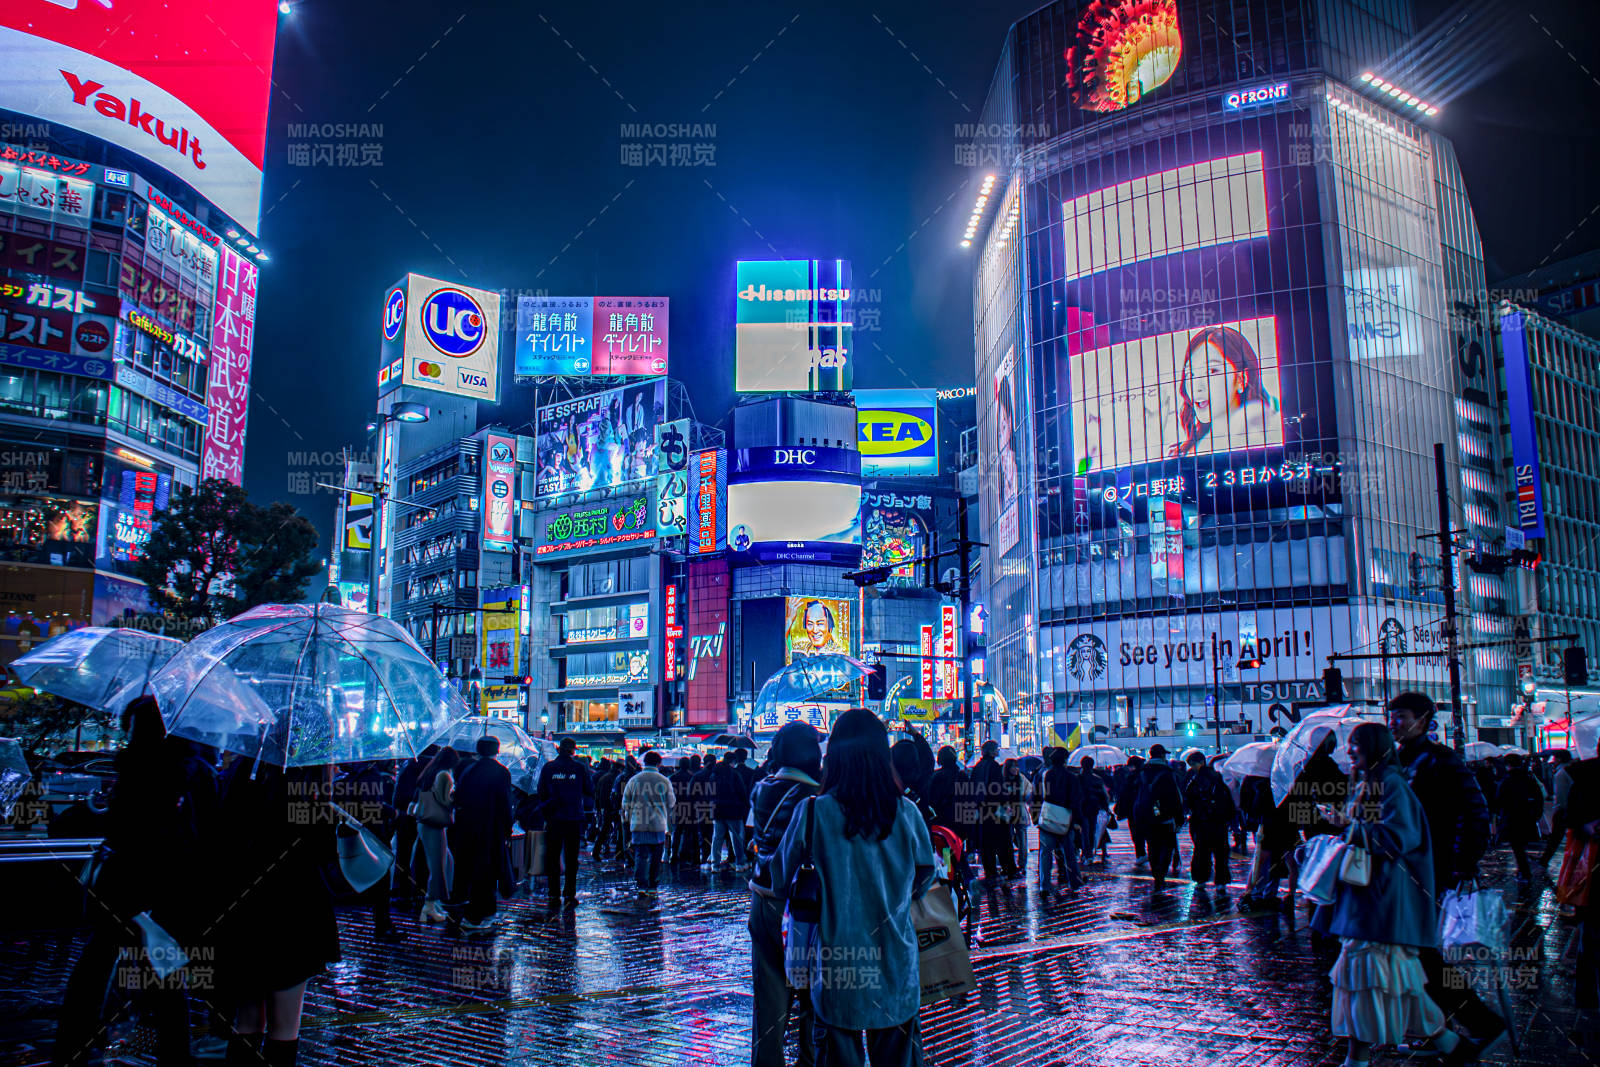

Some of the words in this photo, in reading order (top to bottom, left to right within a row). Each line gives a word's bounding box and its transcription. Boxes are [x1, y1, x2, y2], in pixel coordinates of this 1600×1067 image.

[1227, 84, 1288, 108] QFRONT
[58, 69, 206, 170] Yakult
[0, 242, 79, 271] イス
[0, 284, 24, 298] ラン
[27, 283, 96, 314] ガスト
[533, 313, 577, 332] 龍角散
[609, 313, 654, 332] 龍角散
[173, 333, 207, 364] ガスト
[526, 333, 585, 353] ダイレクト
[603, 333, 662, 353] ダイレクト
[460, 372, 488, 388] VISA
[541, 408, 554, 422] LE
[775, 449, 816, 465] DHC
[659, 423, 688, 533] もんじゃ
[700, 457, 714, 546] 三千里薬品
[1516, 463, 1539, 527] SEIBU
[574, 516, 607, 537] 西村
[1414, 626, 1430, 642] See
[689, 622, 726, 680] クスリ
[1120, 642, 1157, 667] See
[1163, 642, 1204, 669] you
[1211, 637, 1233, 660] n
